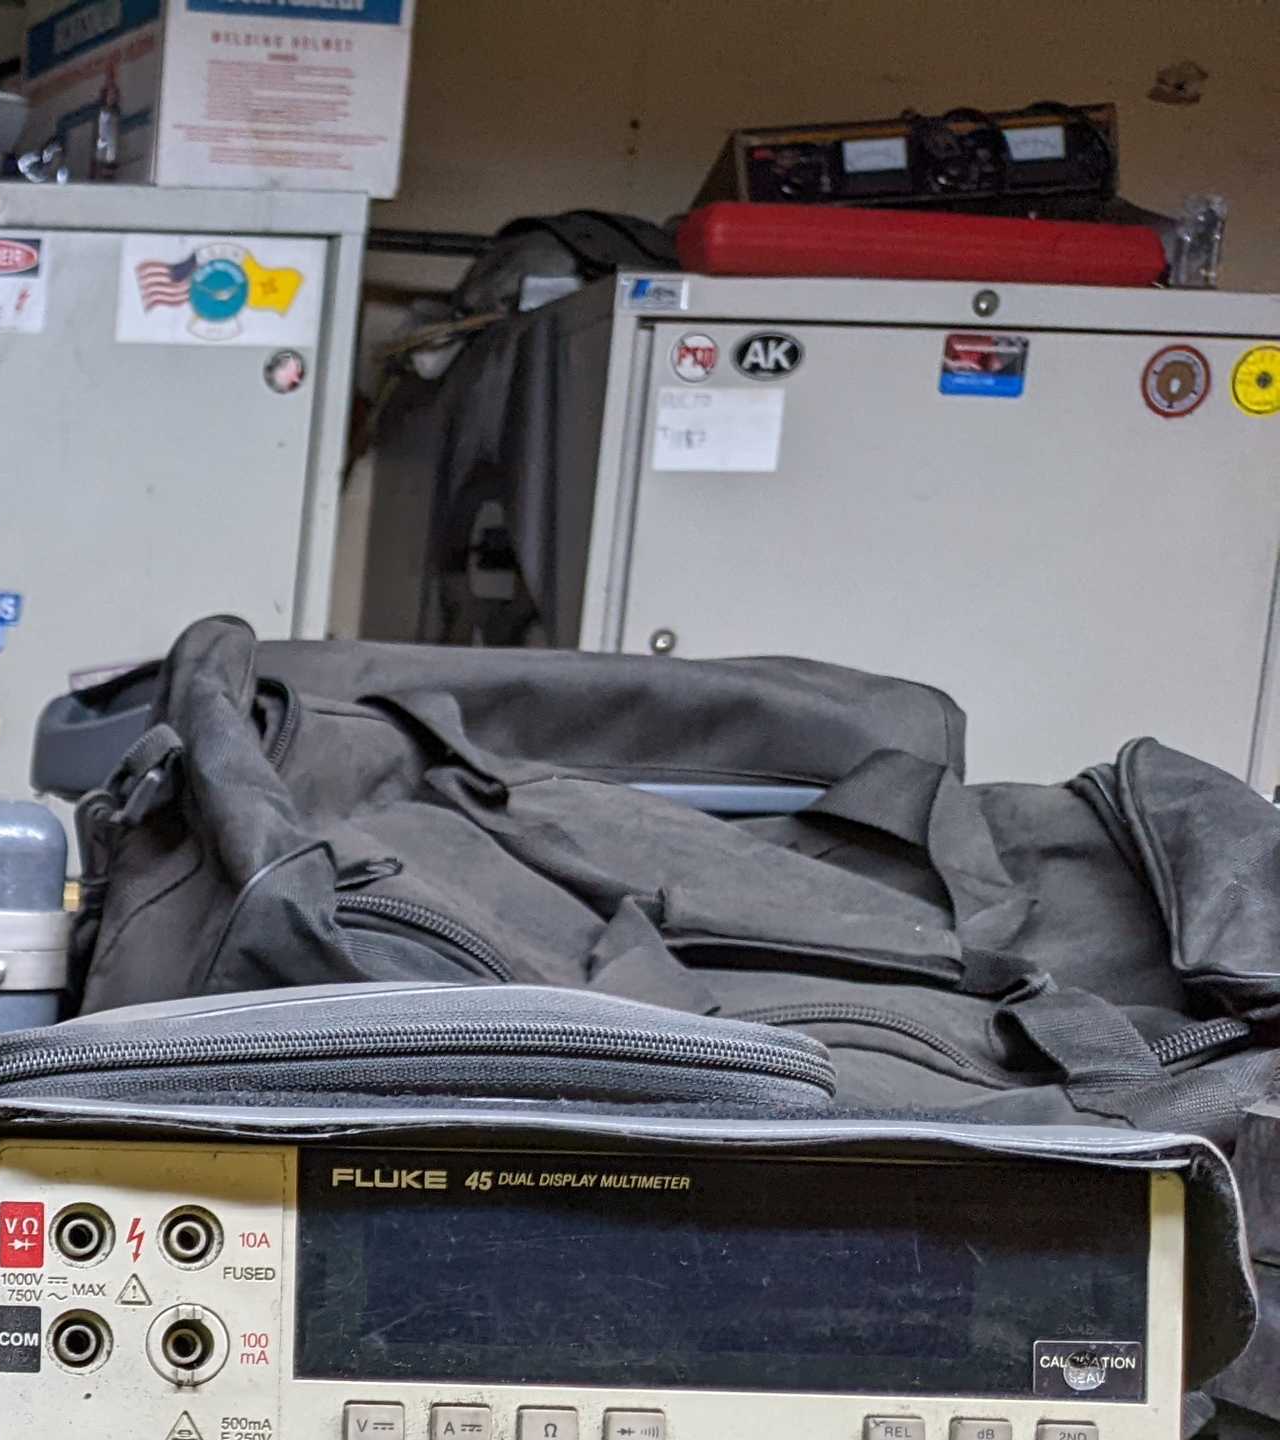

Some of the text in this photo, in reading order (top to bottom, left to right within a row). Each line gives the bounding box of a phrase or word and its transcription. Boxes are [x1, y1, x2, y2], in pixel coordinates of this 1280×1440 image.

[742, 340, 791, 370] AK
[332, 1167, 691, 1191] FLUKE 45 DUAL DISPLAY MULTIMETER
[239, 1232, 271, 1249] 10A
[0, 1272, 43, 1286] 1000V
[223, 1267, 276, 1281] FUSED
[7, 1282, 107, 1302] 750V MAX
[240, 1333, 270, 1349] 100
[239, 1350, 270, 1365] mA
[221, 1417, 272, 1431] 500mA
[883, 1425, 912, 1439] REL
